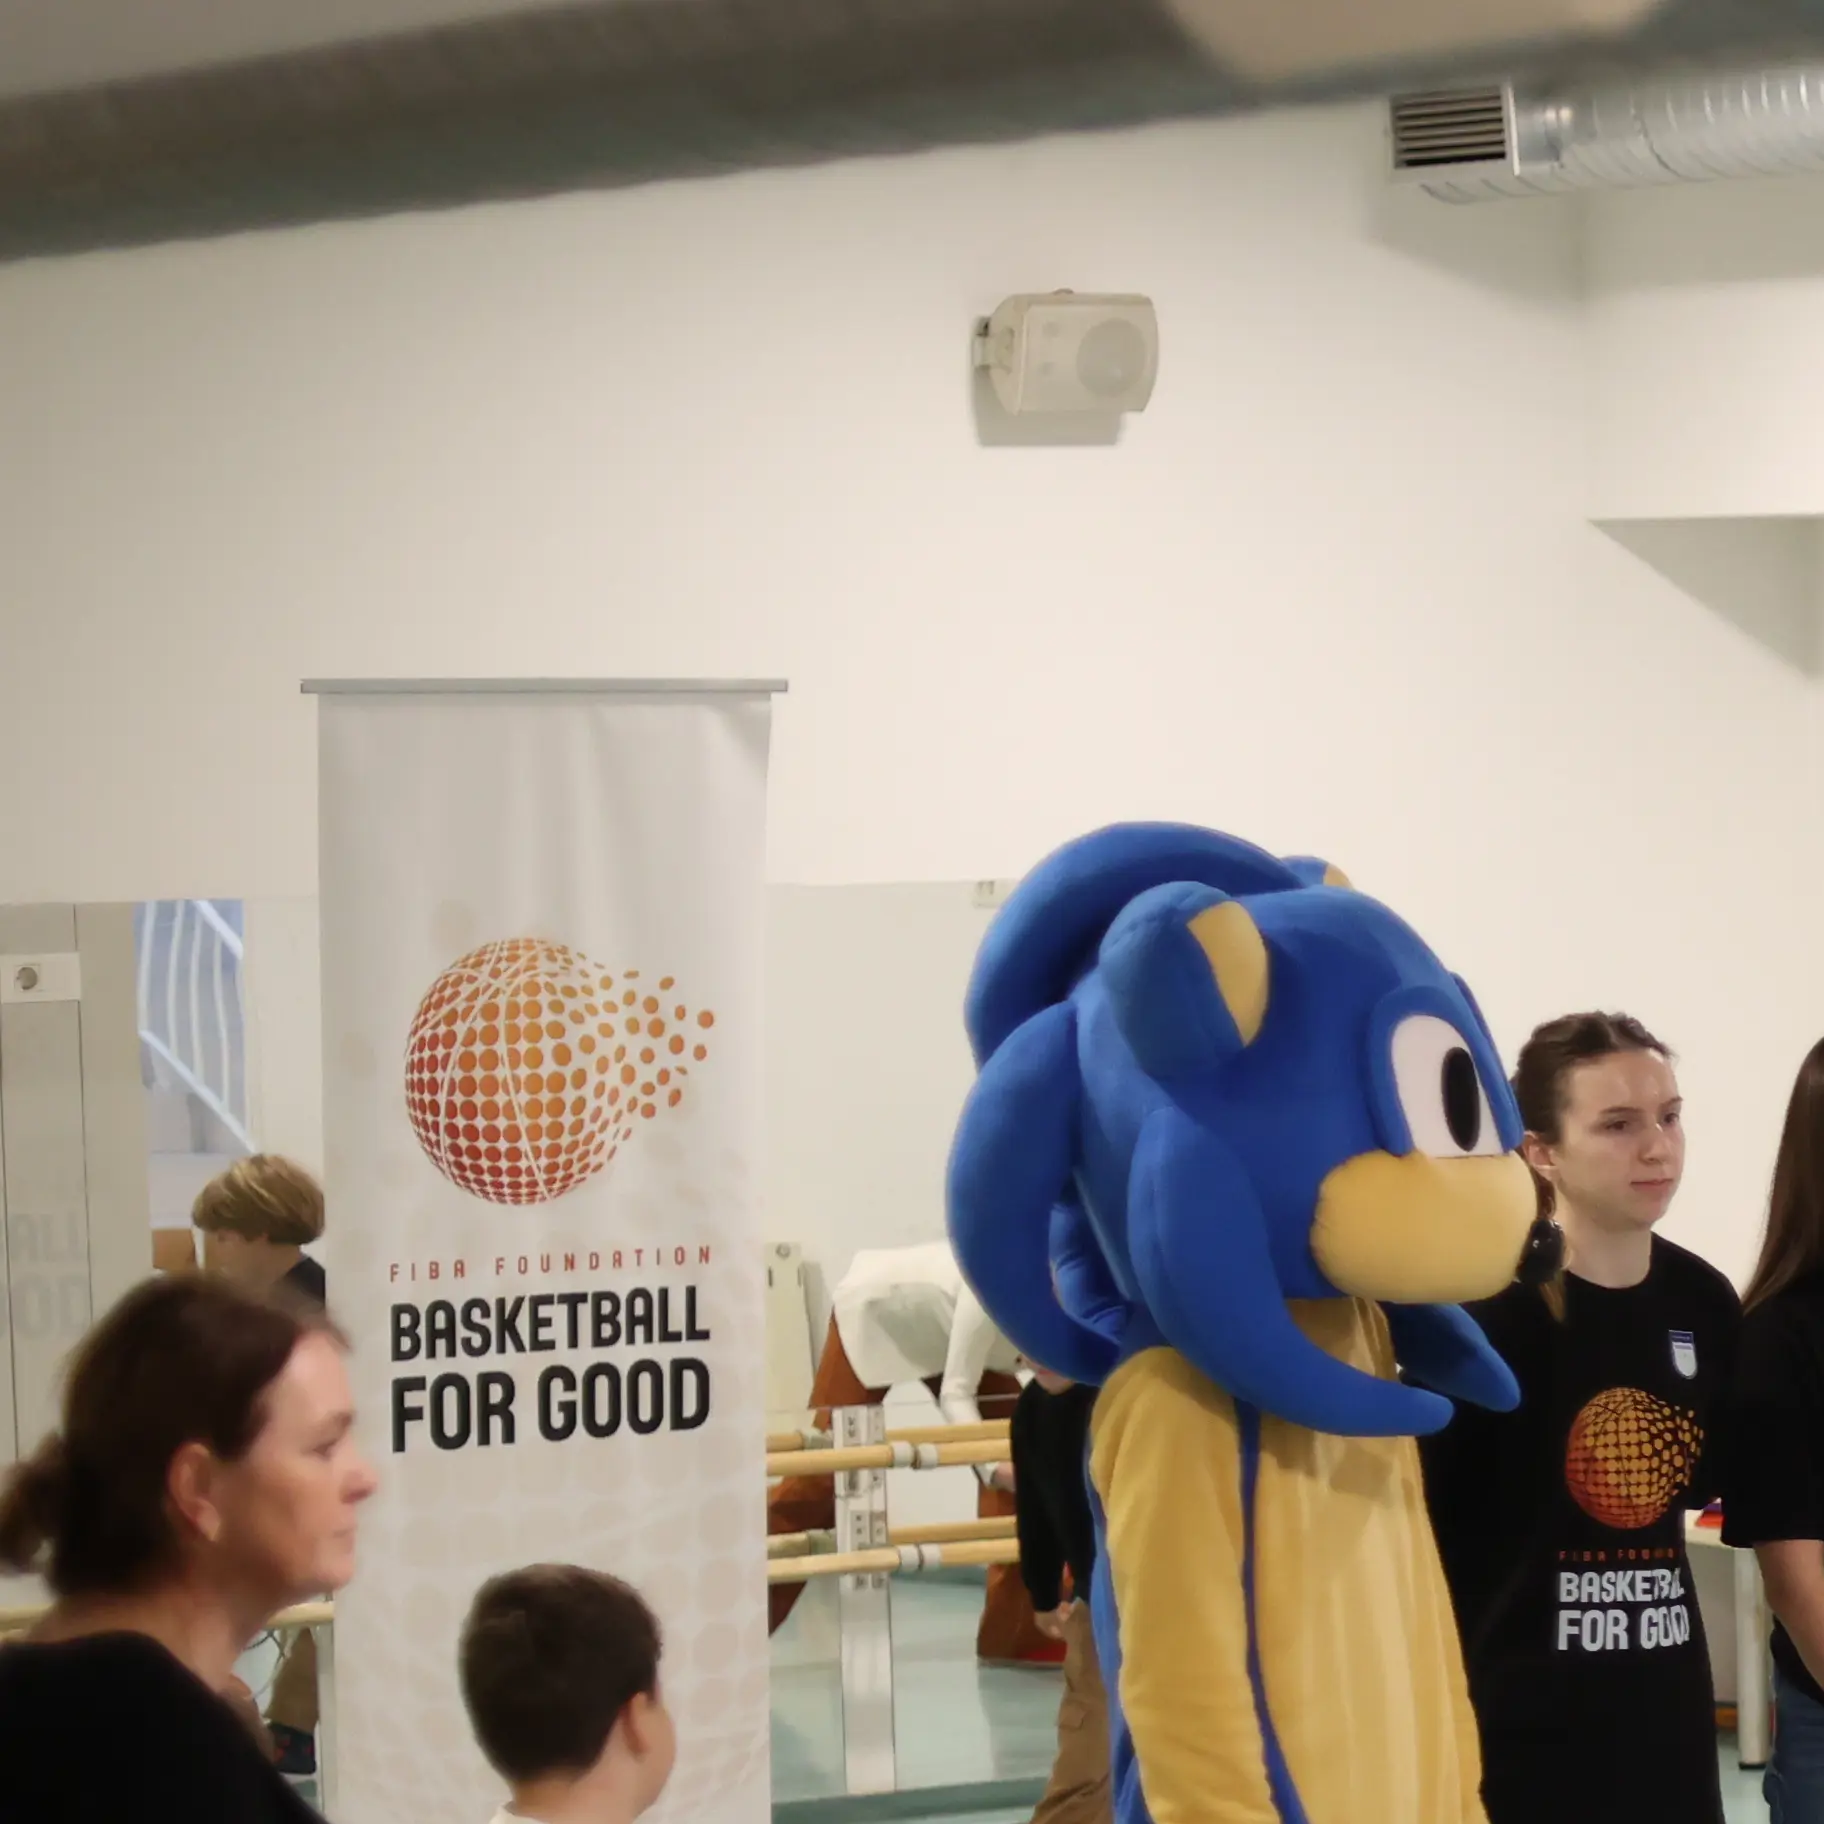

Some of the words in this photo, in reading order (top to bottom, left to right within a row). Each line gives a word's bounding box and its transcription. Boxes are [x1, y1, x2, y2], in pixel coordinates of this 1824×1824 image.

[390, 1259, 466, 1282] FIBA
[495, 1246, 711, 1275] FOUNDATION
[390, 1285, 711, 1362] BASKETBALL
[391, 1371, 516, 1453] FOR
[537, 1357, 711, 1442] GOOD
[1557, 1609, 1629, 1652] FOR
